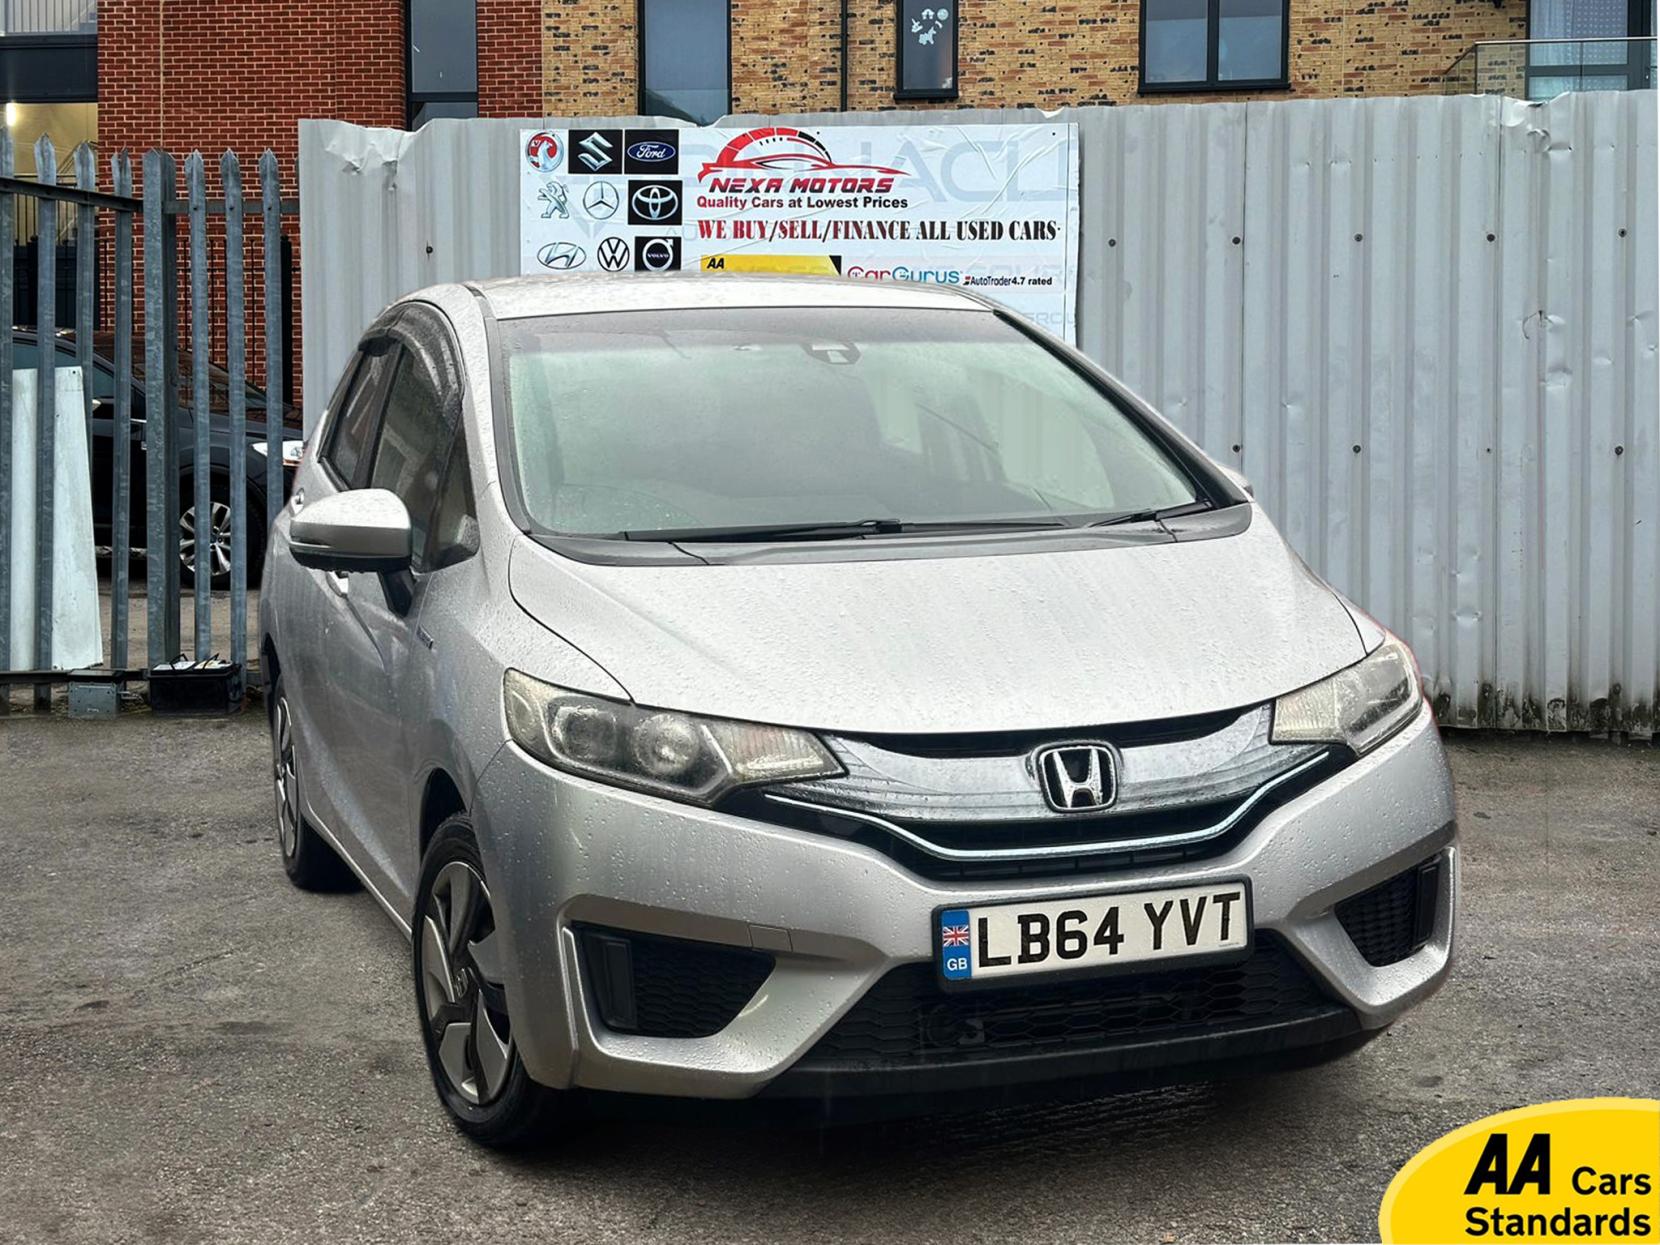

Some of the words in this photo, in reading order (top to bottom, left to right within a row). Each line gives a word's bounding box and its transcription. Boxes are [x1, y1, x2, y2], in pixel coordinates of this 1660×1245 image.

[636, 144, 666, 159] Ford
[709, 177, 783, 194] NEXA
[789, 177, 895, 194] MOTORS
[697, 196, 746, 210] Quality
[751, 196, 784, 209] Cars
[788, 196, 803, 209] at
[807, 196, 859, 209] Lowest
[863, 196, 908, 209] Prices
[697, 219, 727, 240] WE
[732, 219, 911, 242] BUY/SELL/FINANCE
[916, 220, 950, 241] ALL
[956, 220, 1004, 241] USED
[1008, 220, 1057, 241] CARS
[706, 257, 725, 270] AA
[847, 266, 960, 284] CarGurus
[1027, 276, 1053, 286] rated
[977, 905, 1125, 969] LB64
[1143, 891, 1241, 951] YVT
[946, 957, 968, 971] GB
